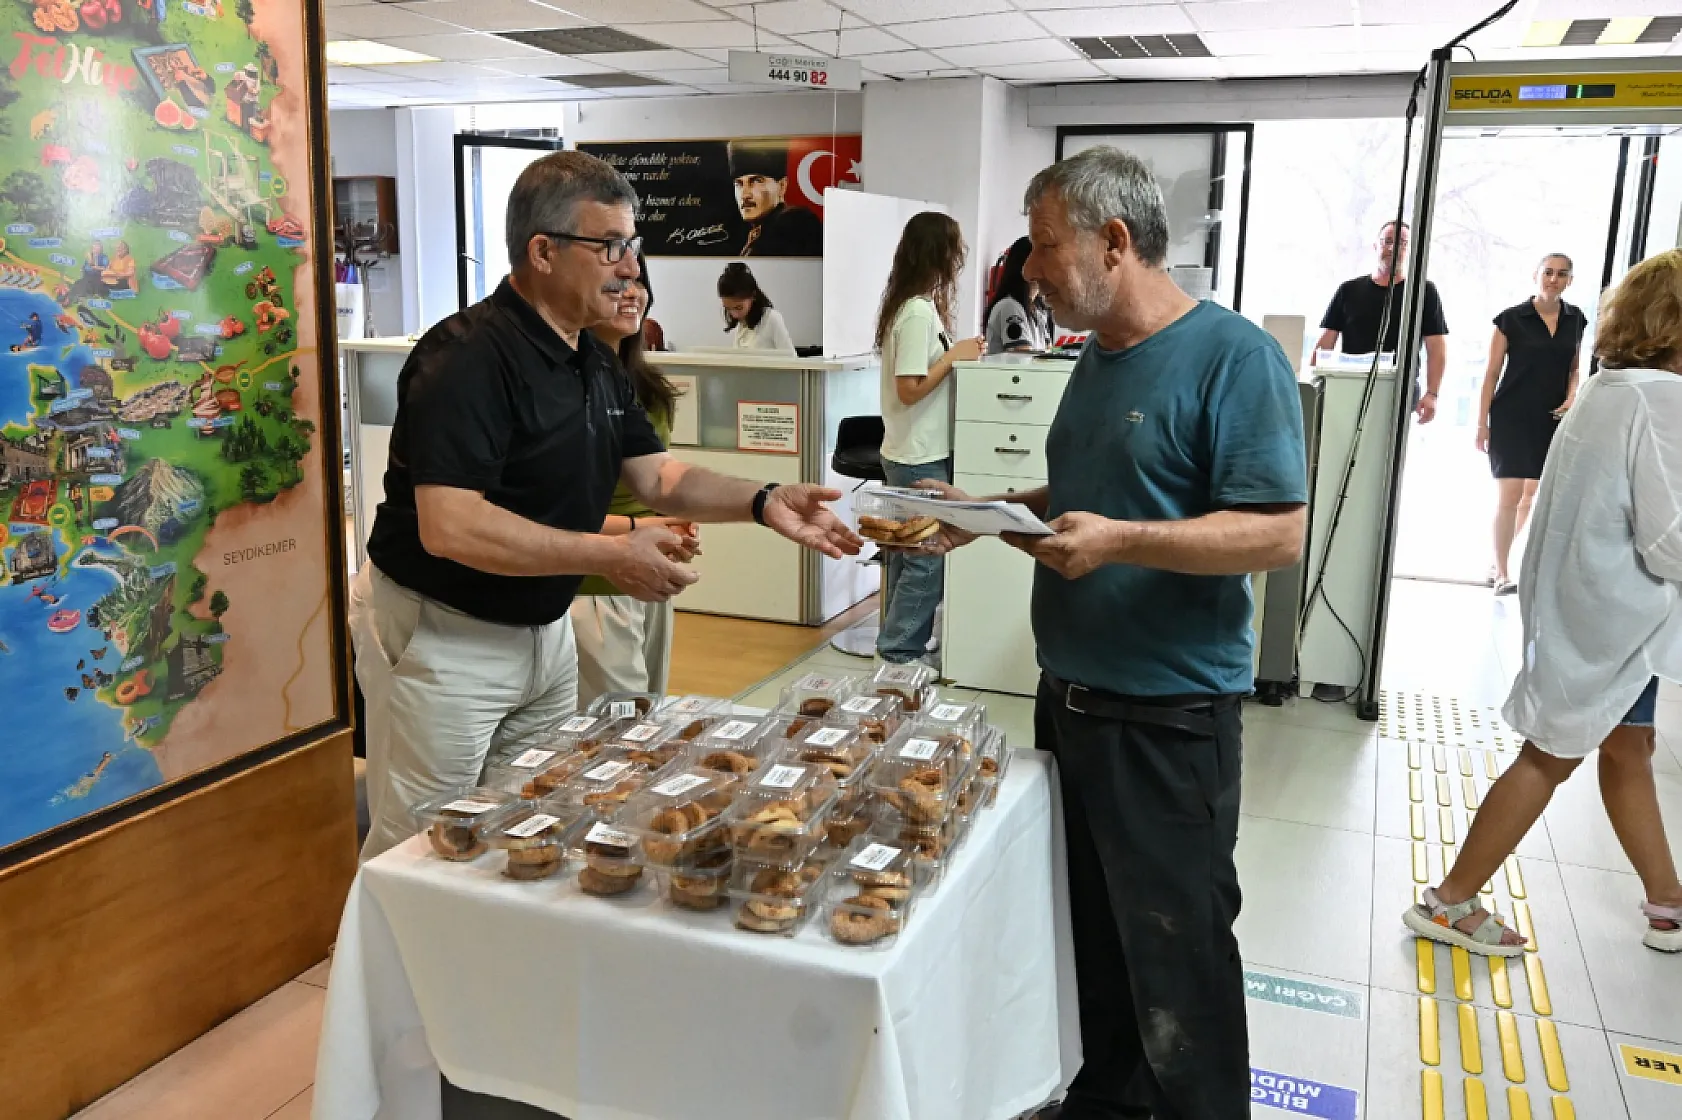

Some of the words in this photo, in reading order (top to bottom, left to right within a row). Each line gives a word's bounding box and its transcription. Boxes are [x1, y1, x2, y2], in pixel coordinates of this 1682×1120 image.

[769, 69, 790, 80] 444
[793, 70, 808, 82] 90
[810, 71, 827, 85] 82
[223, 538, 297, 566] SEYDİKEMER
